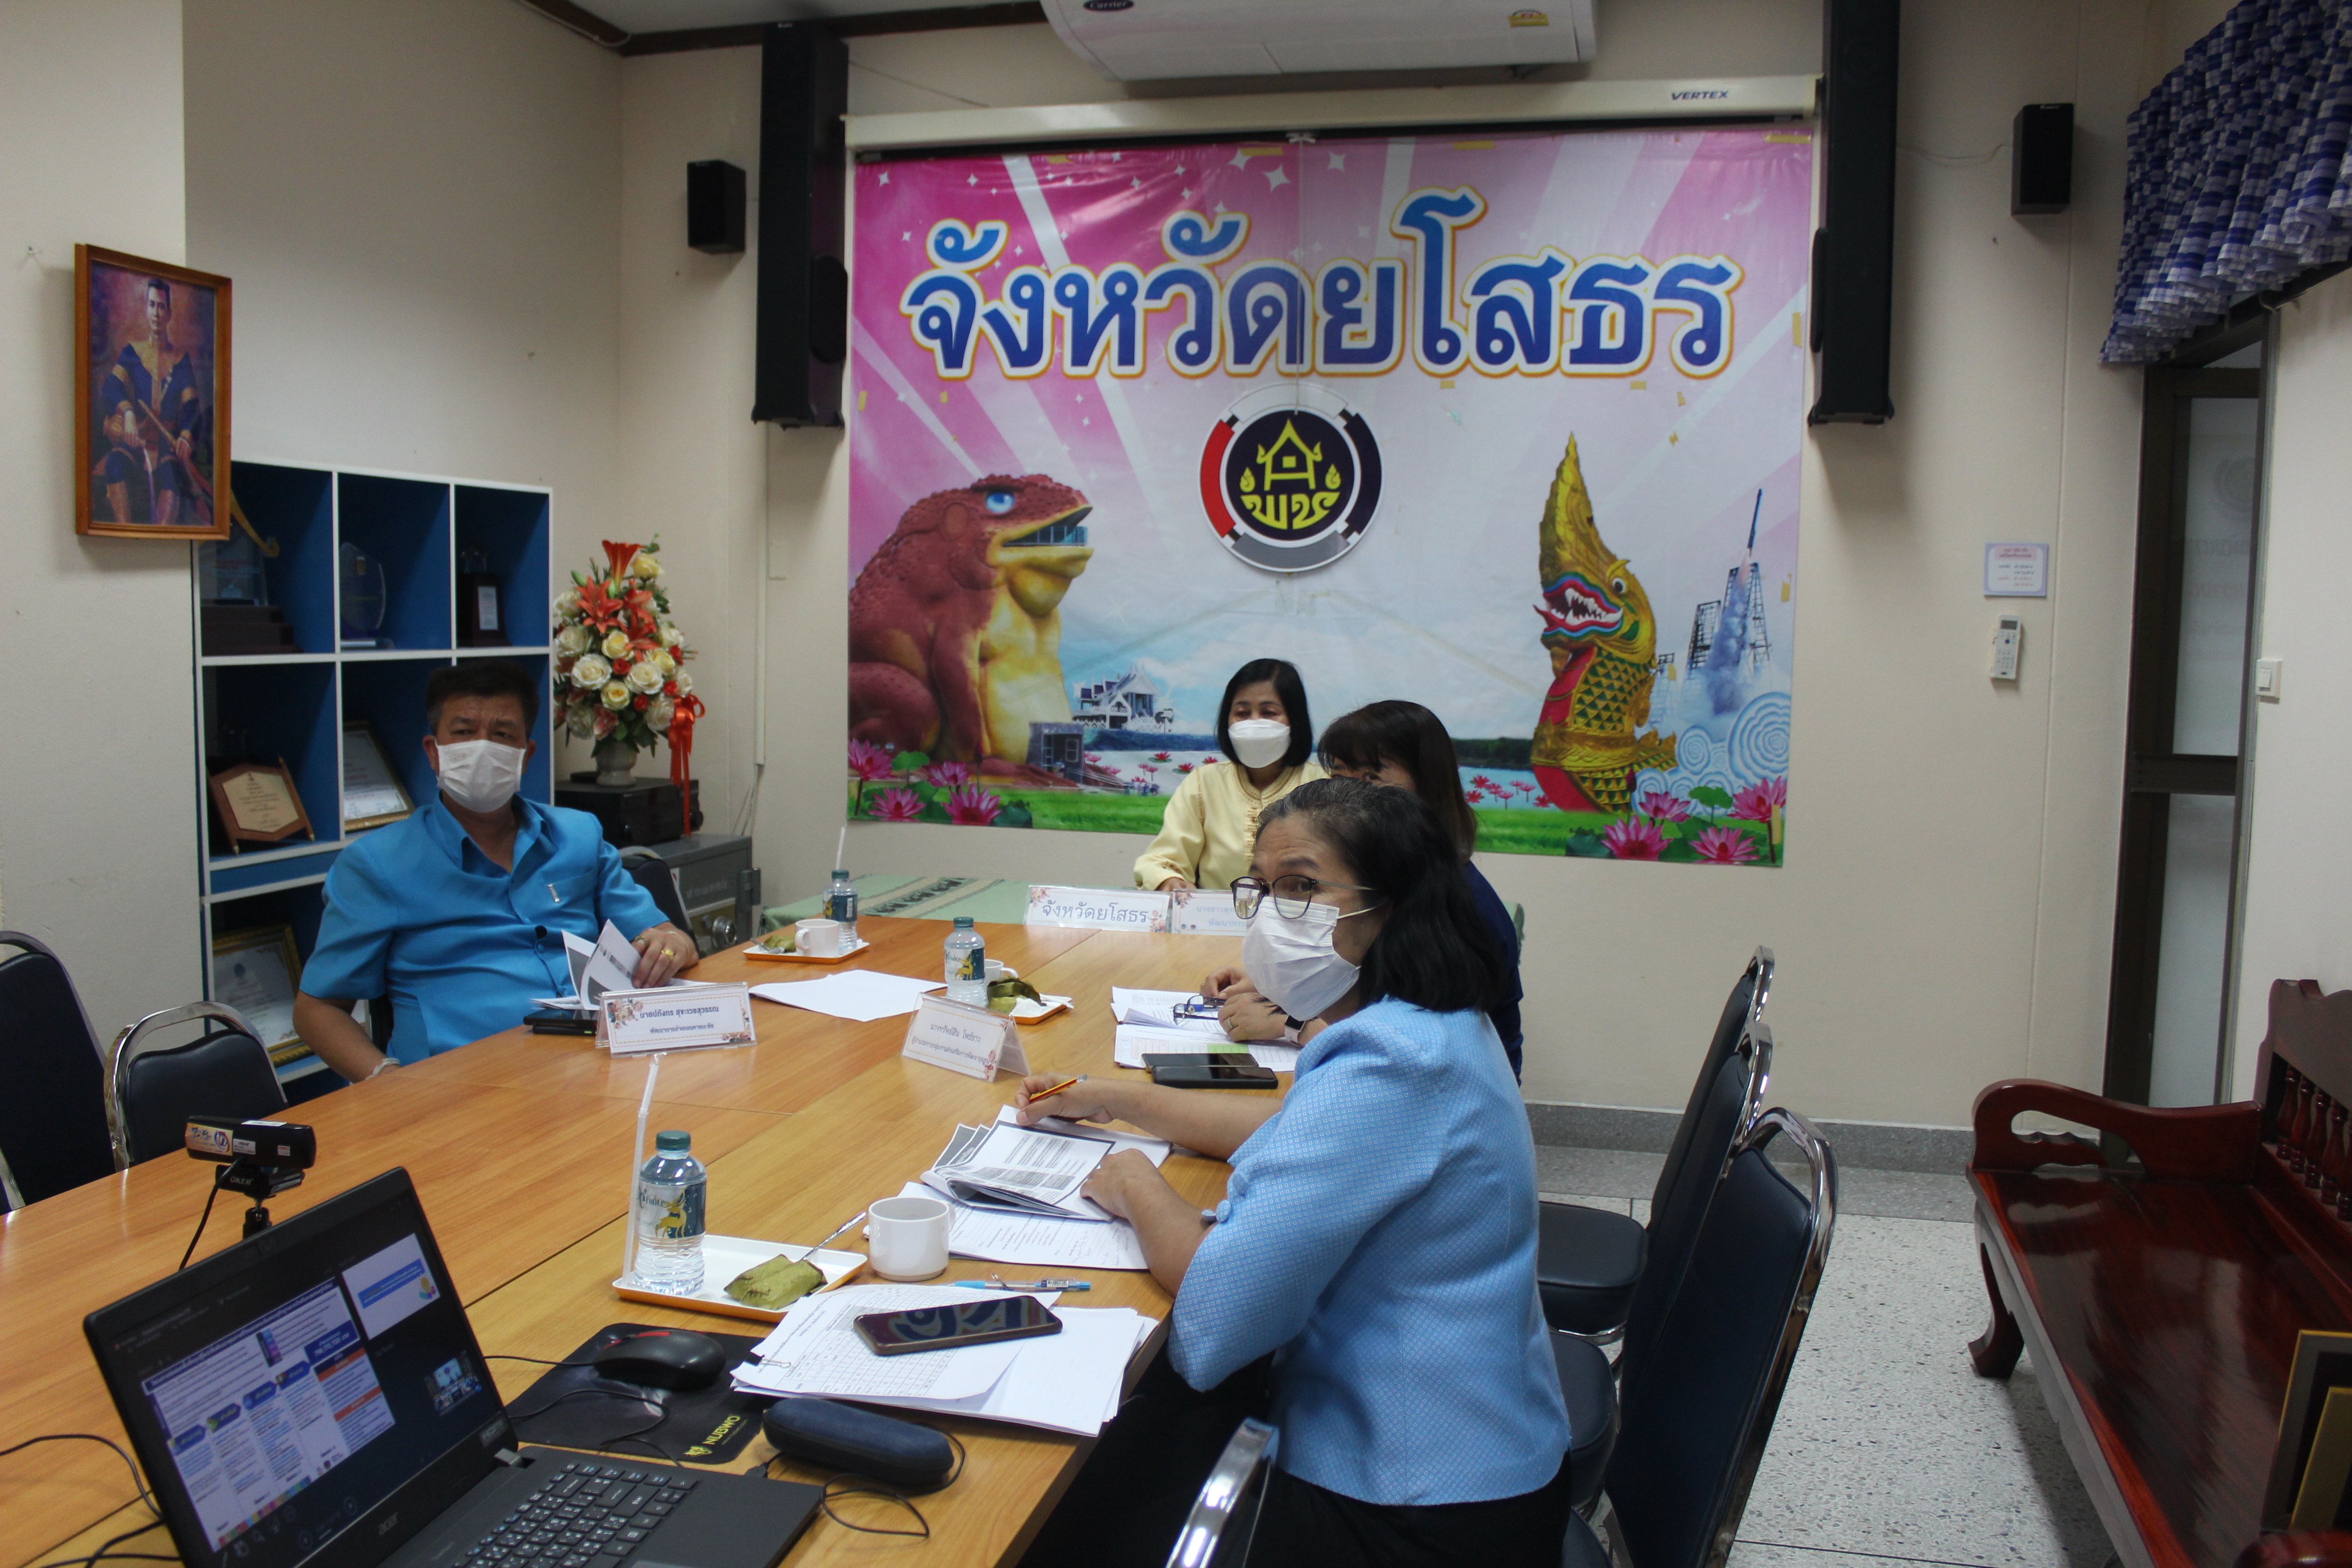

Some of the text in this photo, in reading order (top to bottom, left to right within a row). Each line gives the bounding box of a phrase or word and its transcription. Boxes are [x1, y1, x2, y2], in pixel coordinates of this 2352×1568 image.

[1671, 90, 1729, 100] VERTEX
[903, 188, 1741, 378] จังหวัดยโสธร
[1042, 900, 1149, 924] จังหวัดยโสธร
[230, 1176, 252, 1186] OKER
[702, 1415, 741, 1445] NUBWO
